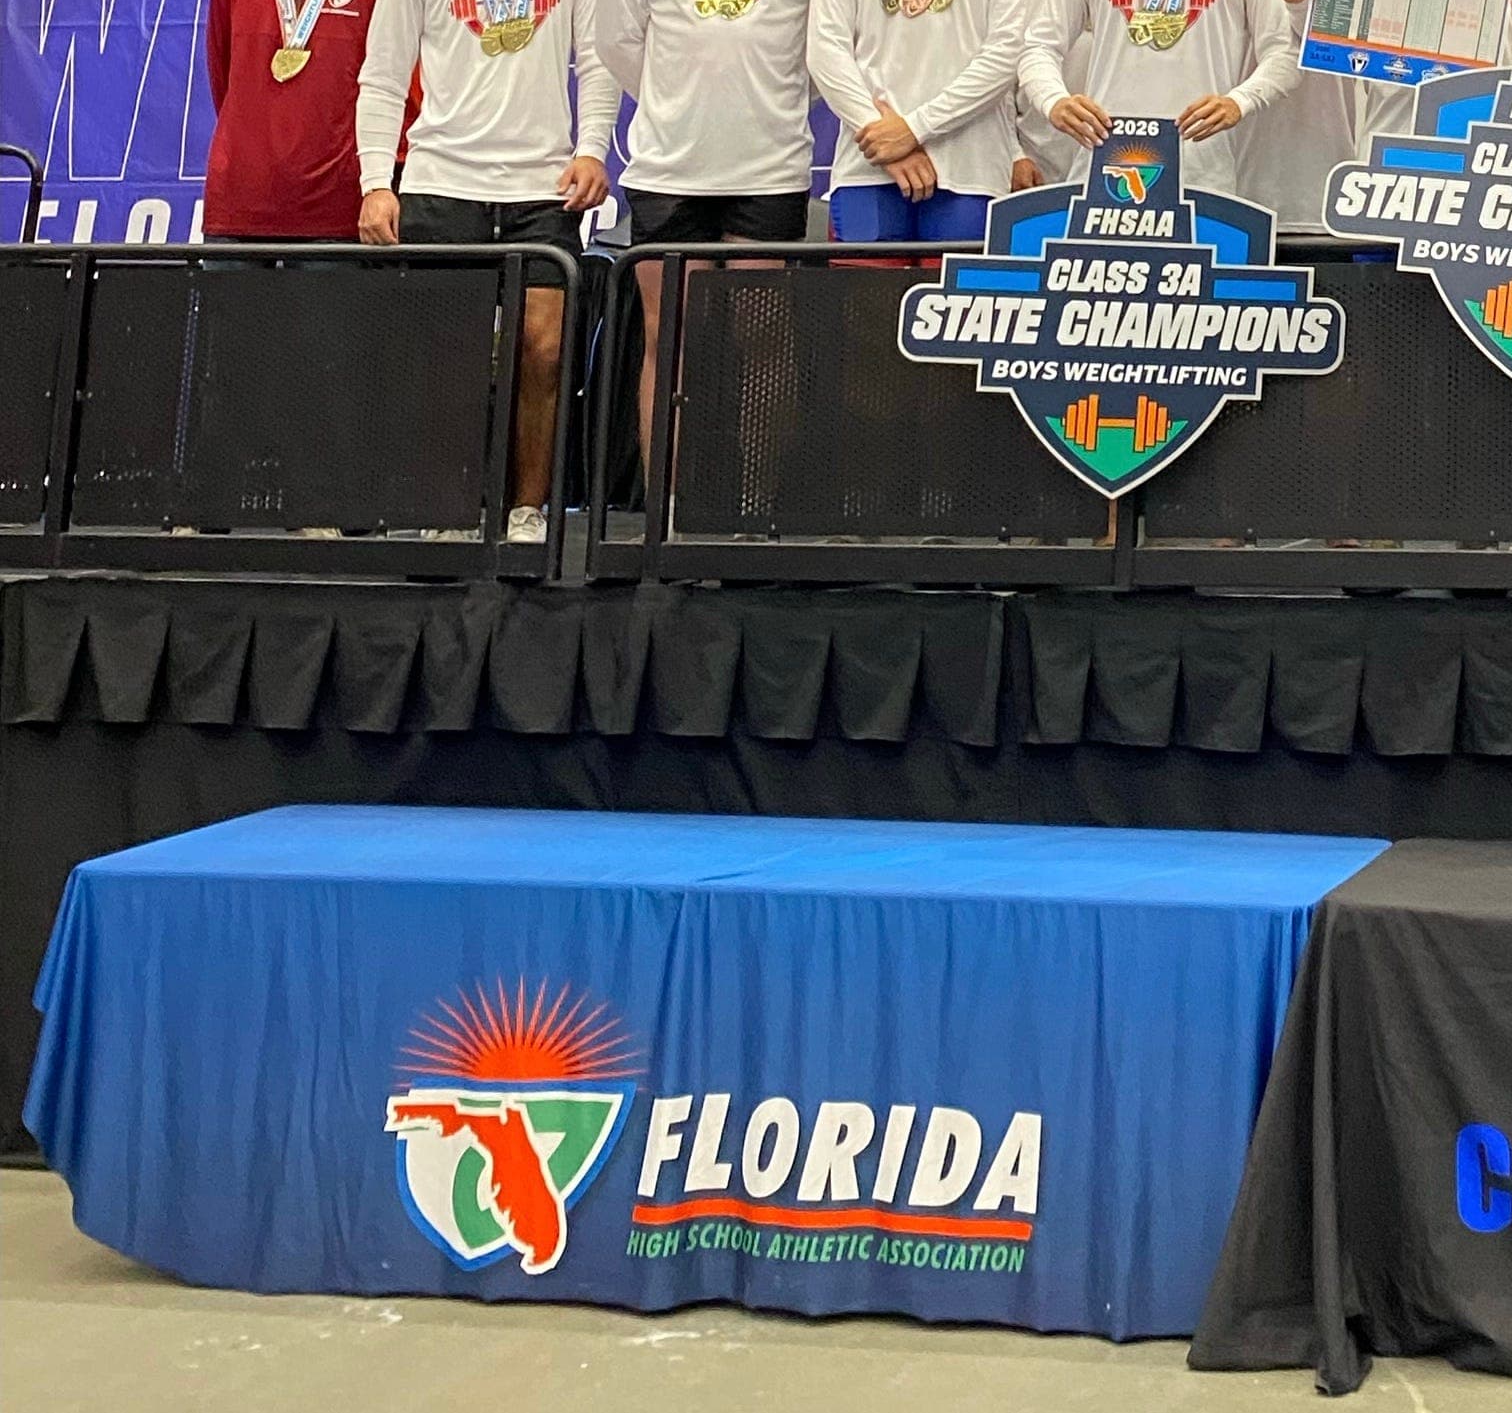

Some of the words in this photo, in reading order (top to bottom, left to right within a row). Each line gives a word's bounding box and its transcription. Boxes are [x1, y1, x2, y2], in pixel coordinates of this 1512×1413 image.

[1113, 120, 1160, 136] 2026
[1335, 171, 1470, 227] STATE
[1083, 208, 1175, 237] FHSAA
[1413, 239, 1480, 265] BOYS
[1047, 258, 1149, 295] CLASS
[1158, 263, 1202, 296] 3A
[911, 294, 1047, 345] STATE
[1056, 301, 1333, 354] CHAMPIONS
[992, 360, 1058, 381] BOYS
[1064, 362, 1247, 387] WEIGHTLIFTING
[637, 1093, 1043, 1215] FLORIDA
[626, 1228, 679, 1259] HIGH
[686, 1224, 761, 1259] SCHOOL
[767, 1232, 873, 1263] ATHLETIC
[876, 1238, 1026, 1274] ASSOCIATION
